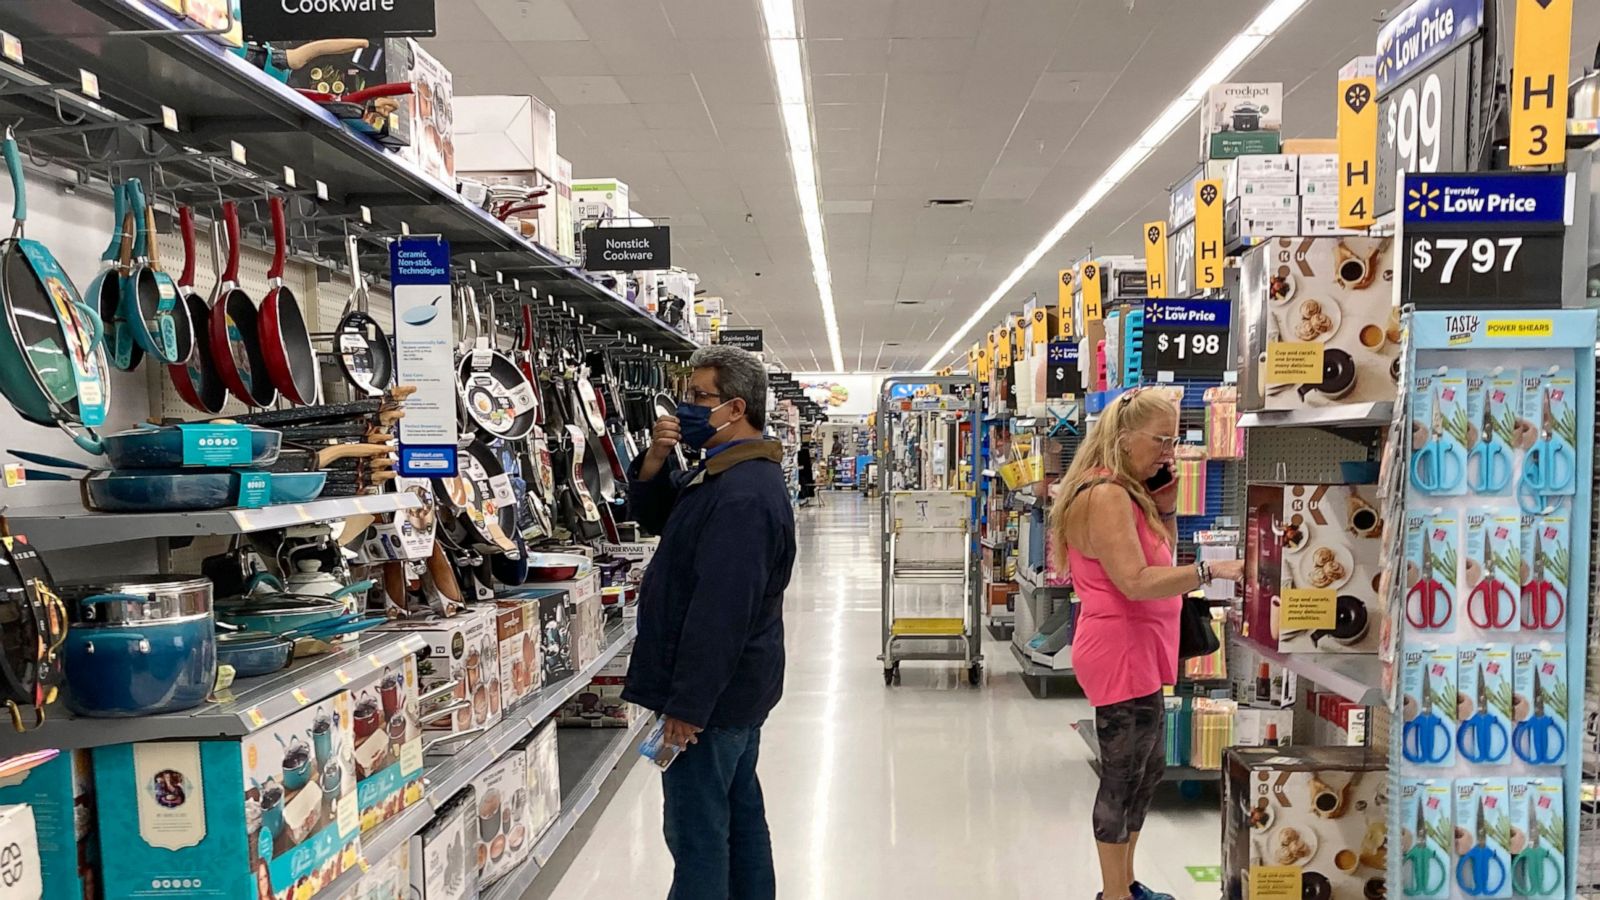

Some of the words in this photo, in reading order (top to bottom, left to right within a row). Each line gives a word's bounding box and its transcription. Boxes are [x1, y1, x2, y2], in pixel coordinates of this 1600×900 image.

[281, 0, 394, 13] Cookware
[1395, 33, 1420, 71] Low
[1421, 7, 1454, 53] Price
[1225, 86, 1269, 96] crockpot
[1523, 74, 1554, 110] H
[1528, 124, 1548, 156] 3
[1346, 160, 1368, 187] H
[1444, 186, 1480, 197] Everyday
[1349, 196, 1367, 220] 4
[1443, 195, 1485, 213] Low
[1487, 193, 1537, 213] Price
[605, 238, 650, 249] Nonstick
[397, 250, 427, 258] Ceramic
[603, 250, 654, 261] Cookware
[1201, 241, 1217, 260] H
[398, 258, 433, 266] Non-stick
[1412, 237, 1523, 284] $797
[398, 266, 446, 276] Technologies
[1204, 267, 1215, 283] 5
[1150, 273, 1161, 290] H
[1062, 306, 1072, 319] H
[1087, 303, 1097, 317] H
[1164, 310, 1188, 321] Low
[1188, 310, 1216, 321] Price
[1063, 322, 1071, 333] 8
[1445, 315, 1480, 333] TASTY
[1487, 324, 1517, 332] POWER
[1518, 324, 1550, 332] SHEARS
